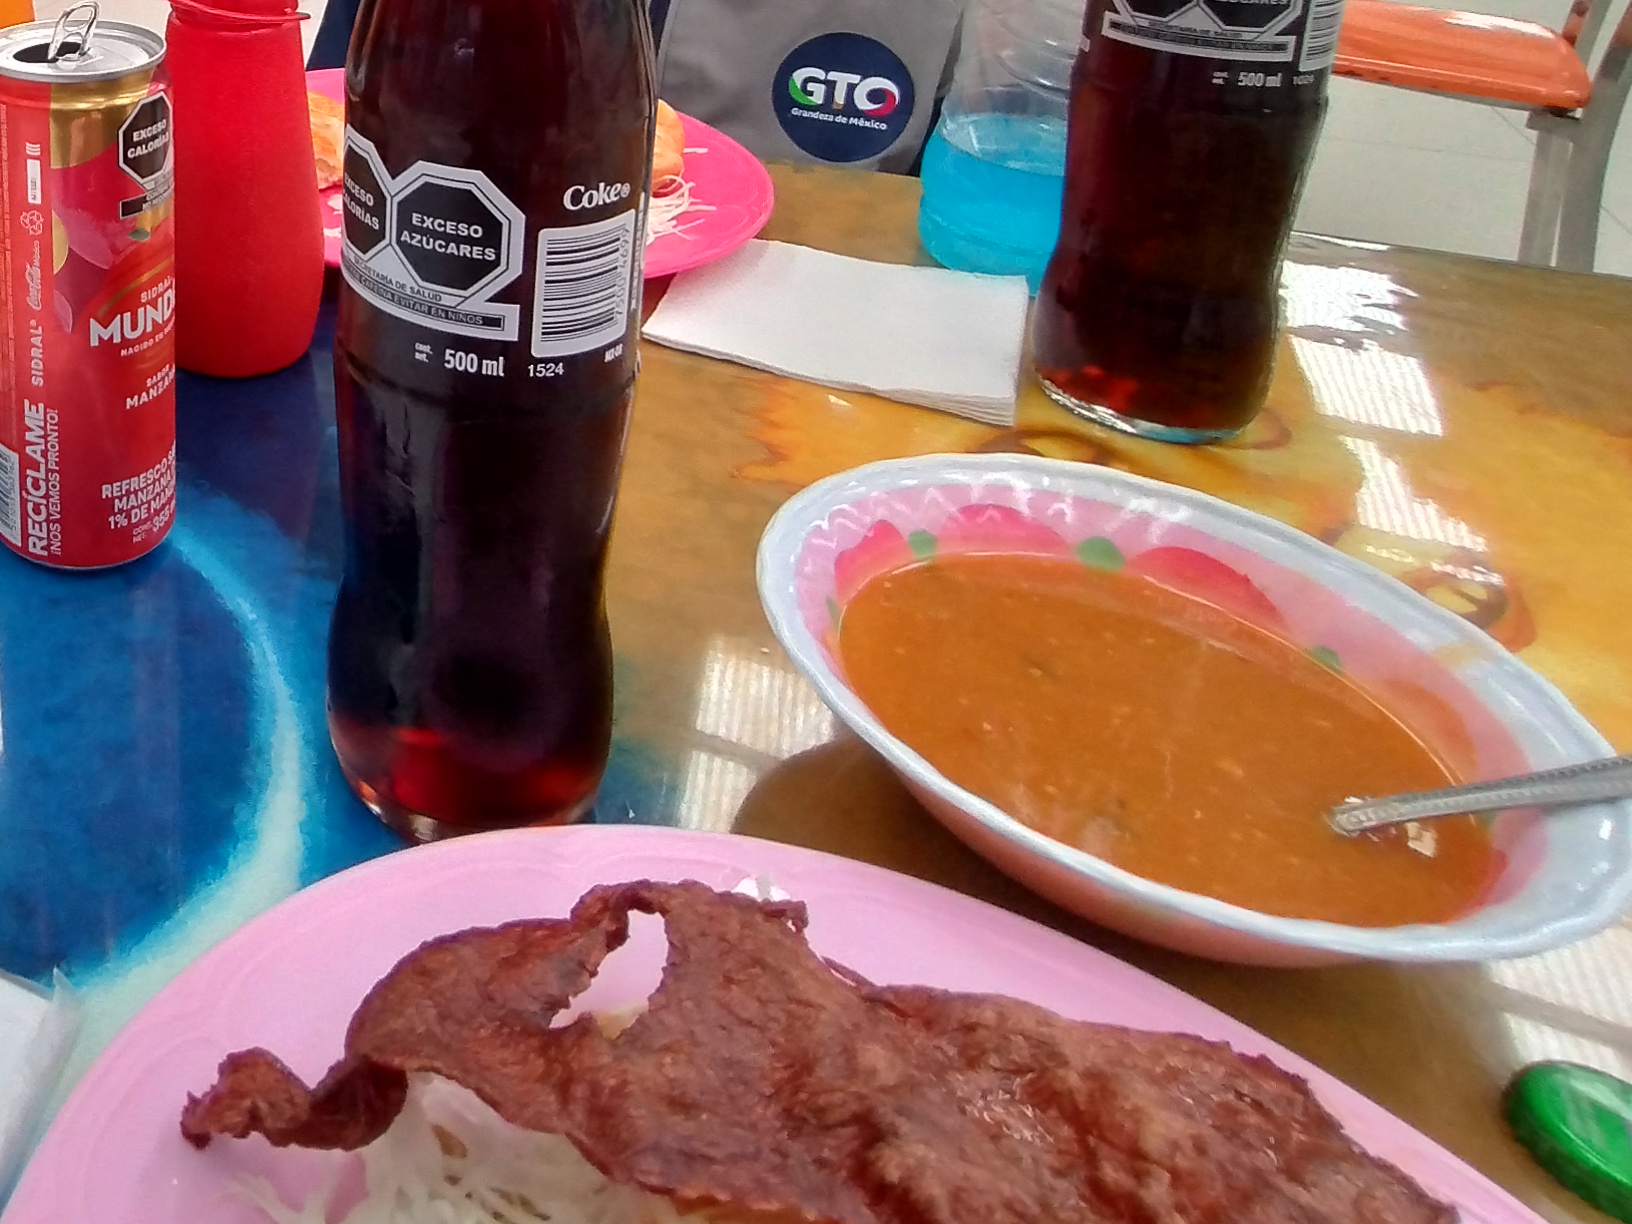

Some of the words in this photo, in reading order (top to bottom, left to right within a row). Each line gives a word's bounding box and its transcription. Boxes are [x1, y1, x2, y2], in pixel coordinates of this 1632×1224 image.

[789, 67, 899, 117] GTO
[1238, 72, 1264, 87] 500
[132, 118, 167, 142] EXCESO
[791, 108, 834, 122] Grandeza
[835, 114, 847, 124] de
[849, 116, 887, 131] México
[344, 172, 374, 207] EXCESO
[412, 212, 483, 238] EXCESO
[400, 230, 496, 261] AZÚCARES
[354, 256, 394, 287] SECRETARÍA
[395, 280, 407, 292] DE
[409, 285, 442, 302] SALUD
[90, 281, 175, 347] MUND
[394, 293, 430, 314] EVITAR
[430, 305, 446, 318] EN
[444, 349, 478, 374] 500
[481, 356, 505, 377] ml
[527, 362, 564, 377] 1524
[126, 364, 175, 409] MANZAN
[46, 408, 59, 470] PRONTO!
[23, 399, 48, 556] RECÍCLAME
[101, 458, 167, 499] REFRESCO
[48, 473, 60, 519] VEMOS
[109, 512, 128, 529] 1%
[131, 504, 148, 523] DE
